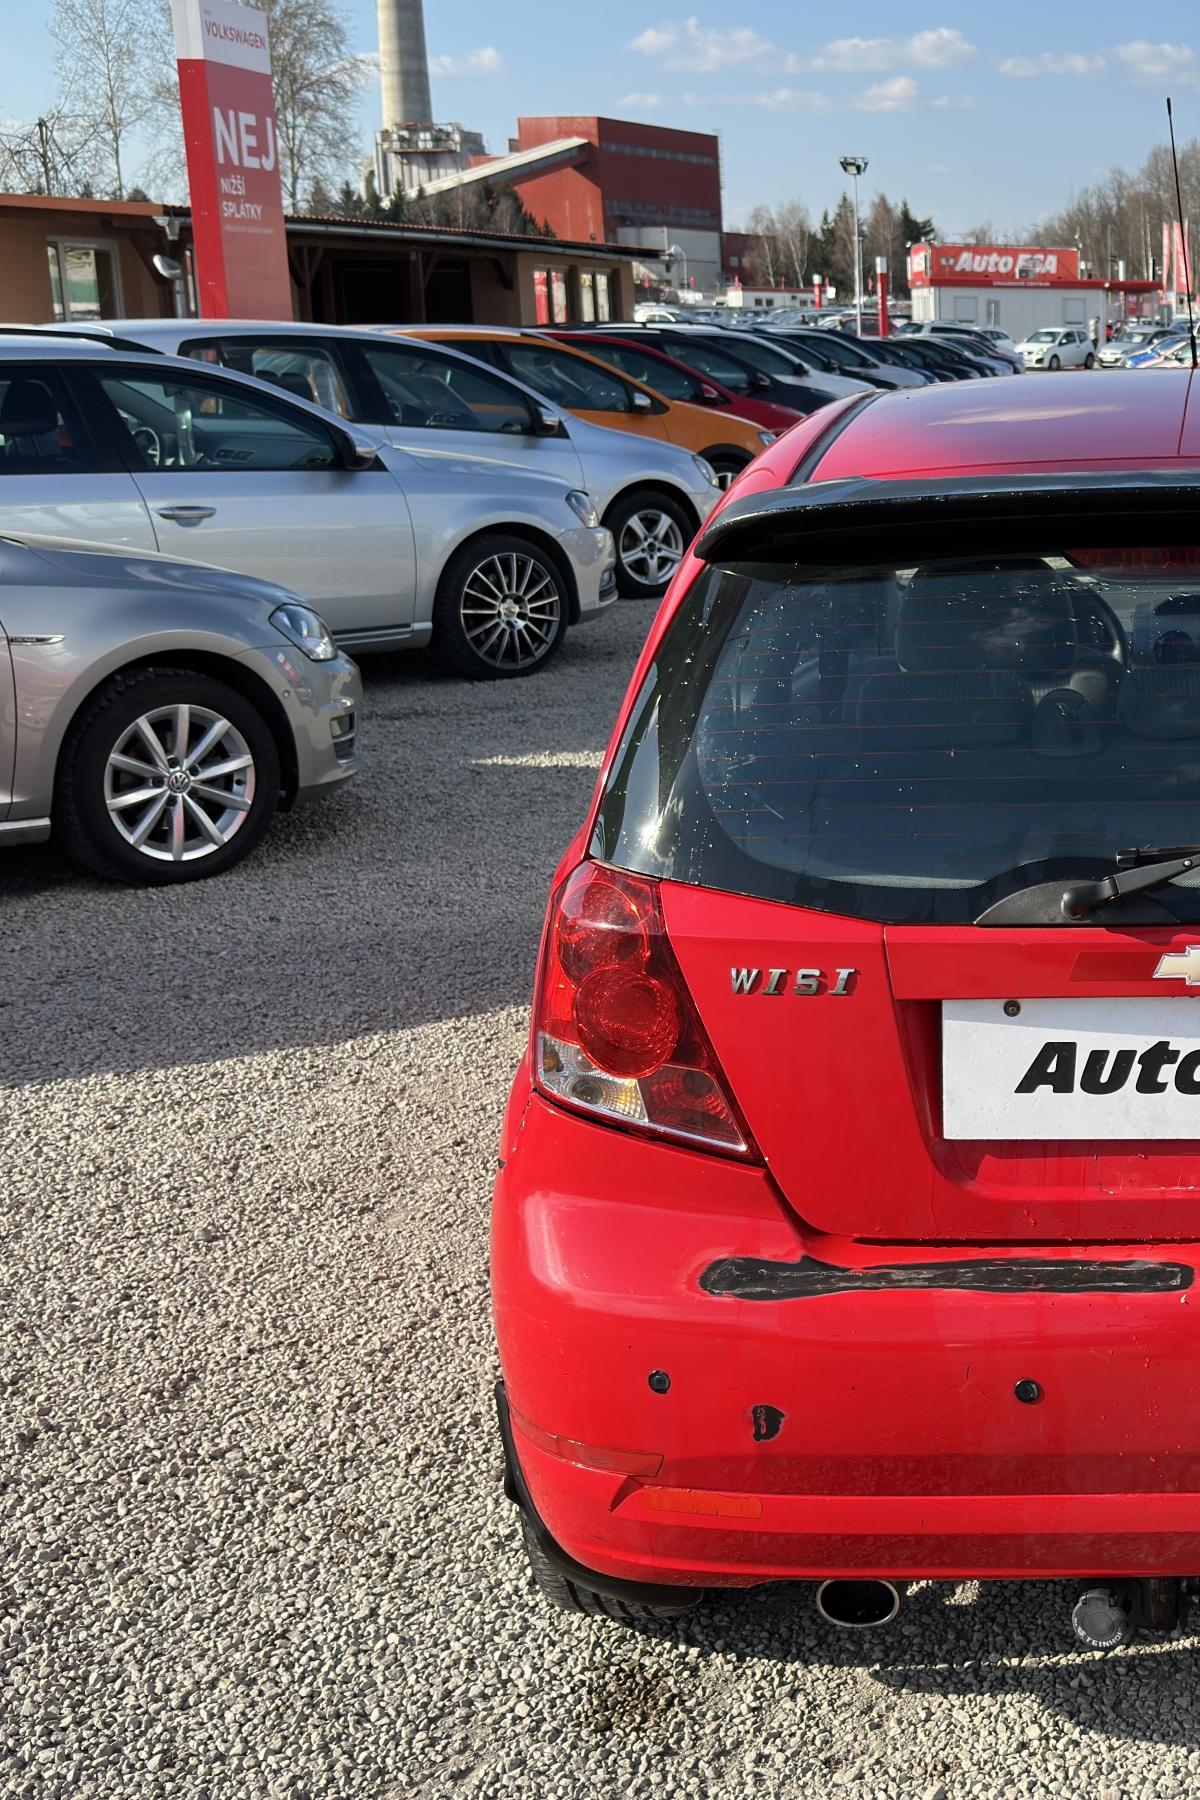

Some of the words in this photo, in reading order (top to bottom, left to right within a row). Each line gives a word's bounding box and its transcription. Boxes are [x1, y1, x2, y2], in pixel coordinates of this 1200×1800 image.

[205, 20, 266, 49] VOLKSWAGEN
[213, 106, 276, 171] NEJ
[222, 198, 263, 220] SPLÁTKY
[955, 252, 1014, 274] Auto
[731, 967, 856, 995] WISI
